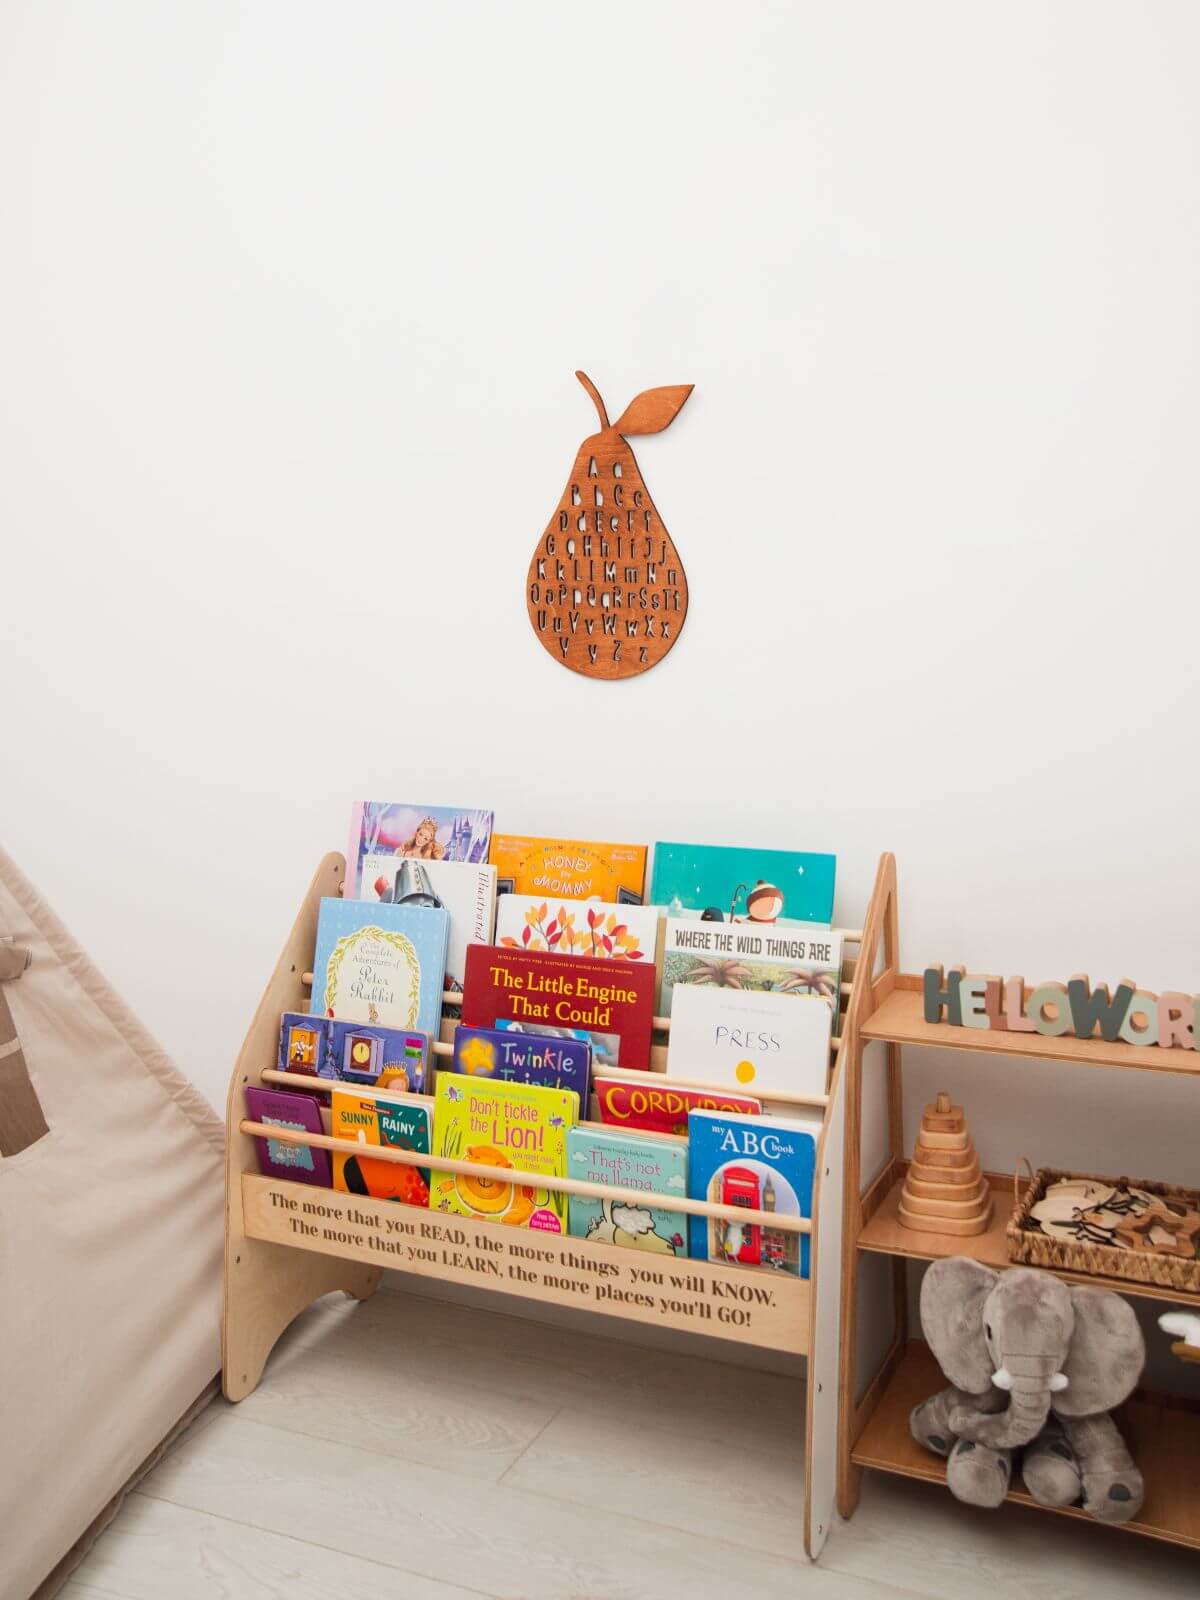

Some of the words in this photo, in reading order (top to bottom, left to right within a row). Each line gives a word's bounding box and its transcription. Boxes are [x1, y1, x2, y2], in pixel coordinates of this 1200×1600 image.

[473, 872, 489, 941] Illustrated
[676, 929, 711, 949] WHERE
[714, 933, 733, 951] THE
[737, 936, 762, 954] WILD
[766, 939, 805, 959] THINGS
[809, 943, 832, 962] ARE
[359, 966, 389, 984] Peter
[490, 967, 523, 989] The
[527, 972, 573, 995] Little
[576, 978, 637, 1004] Engine
[351, 983, 393, 1003] Rabbit
[509, 995, 549, 1018] That
[556, 1002, 610, 1026] Could
[715, 1026, 781, 1051] PRESS
[501, 1043, 577, 1076] Twinkle,
[341, 1111, 374, 1126] SUNNY
[382, 1117, 415, 1136] RAINY
[470, 1097, 500, 1116] Don't
[504, 1101, 538, 1122] tickle
[470, 1116, 489, 1134] the
[492, 1120, 545, 1152] Lion!
[712, 1125, 725, 1135] my
[720, 1128, 781, 1159] ABC
[771, 1141, 794, 1155] book
[587, 1171, 608, 1186] my
[589, 1150, 631, 1171] That's
[637, 1163, 661, 1176] not
[269, 1192, 298, 1211] The
[302, 1202, 343, 1219] more
[347, 1210, 381, 1228] that
[385, 1219, 416, 1236] you
[420, 1223, 470, 1248] READ,
[475, 1236, 504, 1253] the
[509, 1243, 555, 1264] more
[560, 1249, 619, 1276] things
[630, 1266, 664, 1285] you
[669, 1275, 705, 1294] will
[712, 1281, 777, 1308] KNOW.
[290, 1218, 319, 1237] The
[323, 1229, 364, 1246] more
[368, 1237, 403, 1256] that
[407, 1246, 437, 1262] you
[442, 1250, 504, 1279] LEARN,
[508, 1264, 538, 1284] the
[543, 1275, 590, 1295] more
[595, 1284, 655, 1308] places
[660, 1298, 711, 1319] you'll
[717, 1307, 752, 1327] GO!
